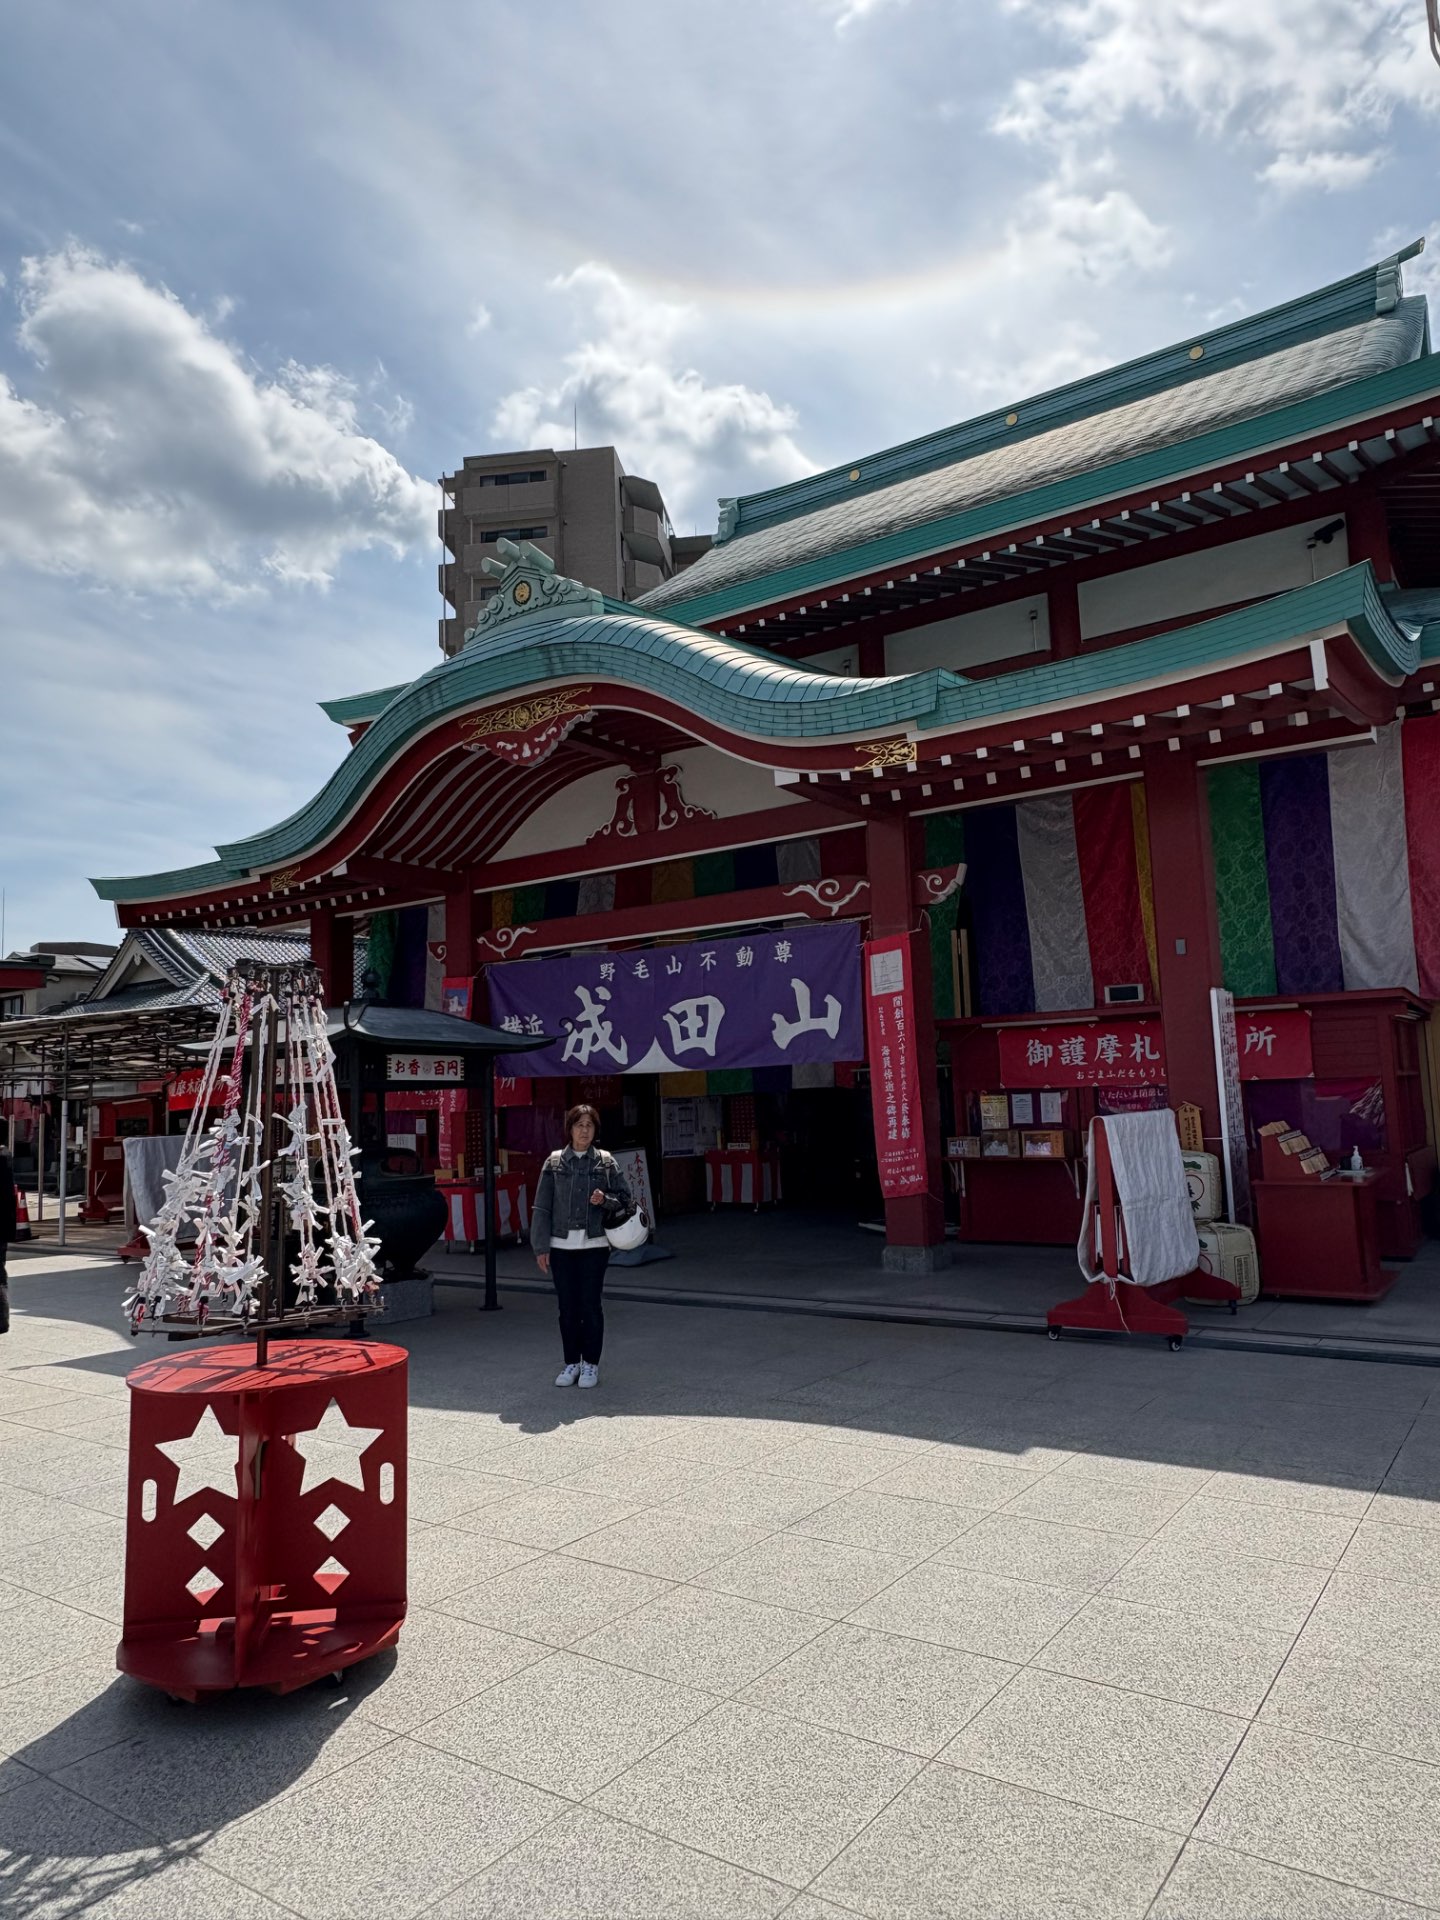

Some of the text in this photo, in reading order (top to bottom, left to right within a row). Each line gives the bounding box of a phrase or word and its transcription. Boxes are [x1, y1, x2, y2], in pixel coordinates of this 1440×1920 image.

[599, 940, 793, 982] 野毛山不動尊
[560, 977, 843, 1067] 成田山
[394, 1058, 458, 1076] お香 百円
[1026, 1026, 1277, 1068] 御護摩札 所
